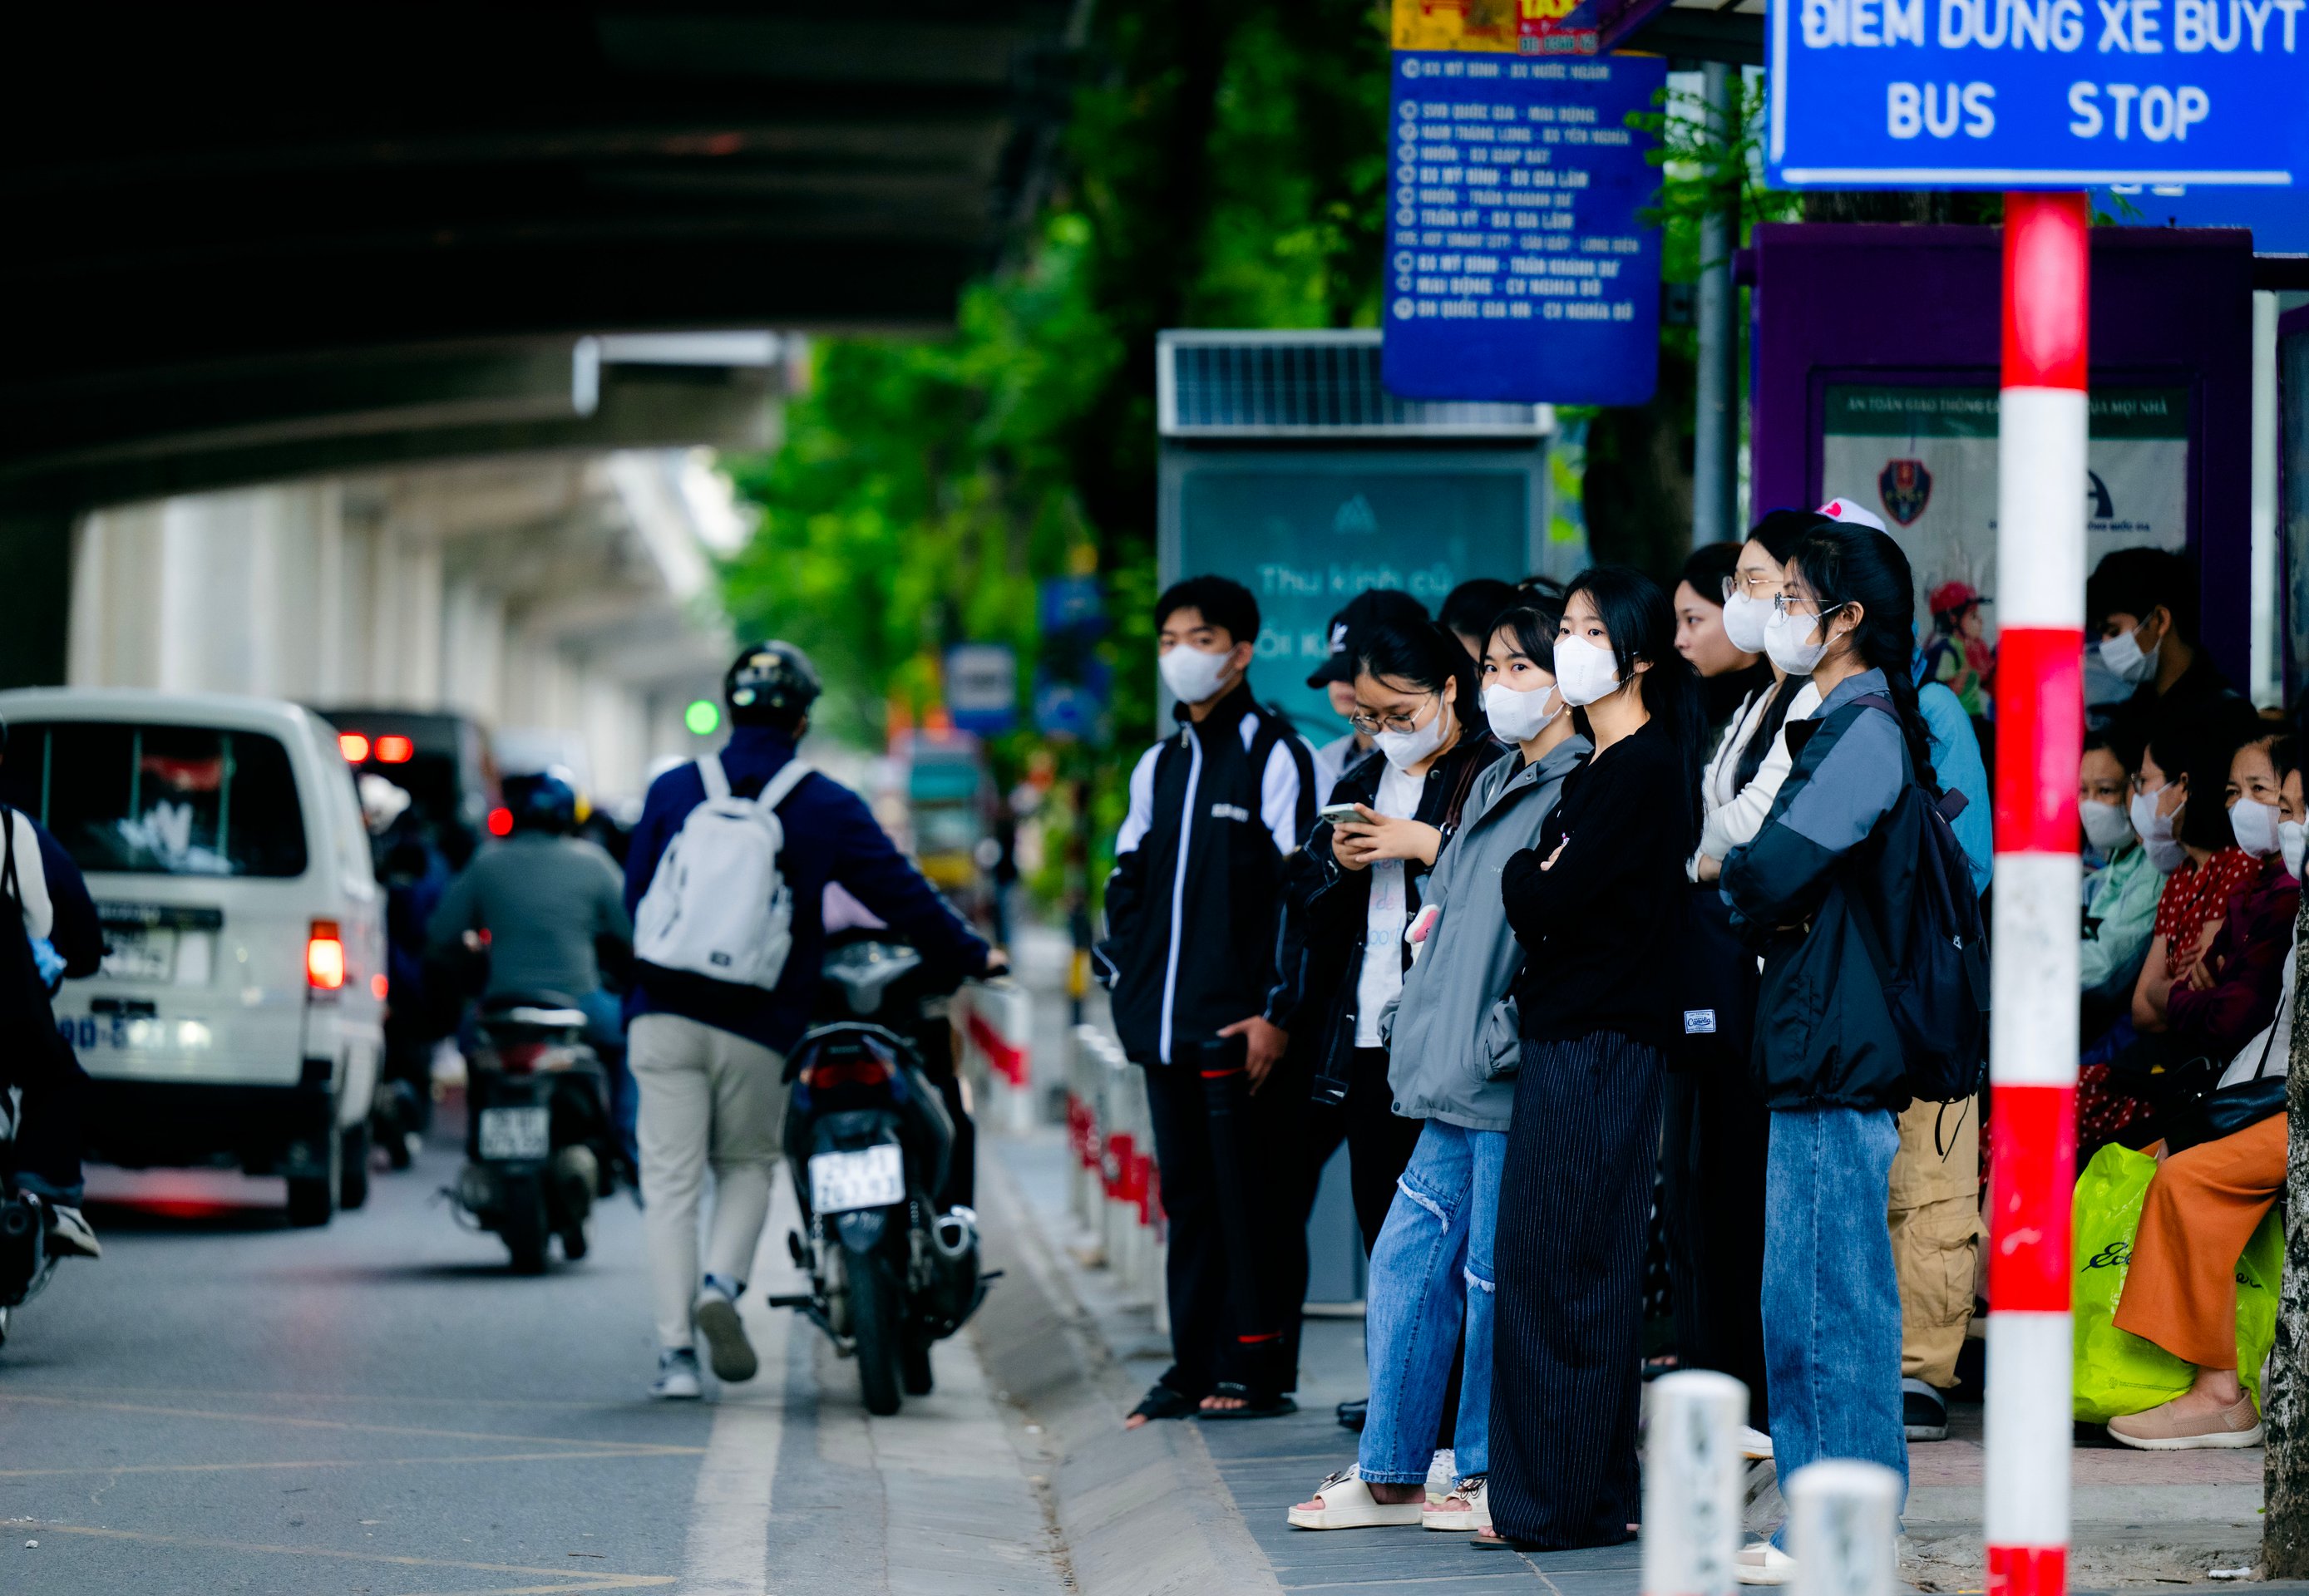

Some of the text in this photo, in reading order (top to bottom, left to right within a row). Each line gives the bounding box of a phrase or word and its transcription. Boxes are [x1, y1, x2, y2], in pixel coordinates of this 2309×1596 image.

[2097, 0, 2164, 53] XE
[1887, 81, 2211, 142] BUS STOP
